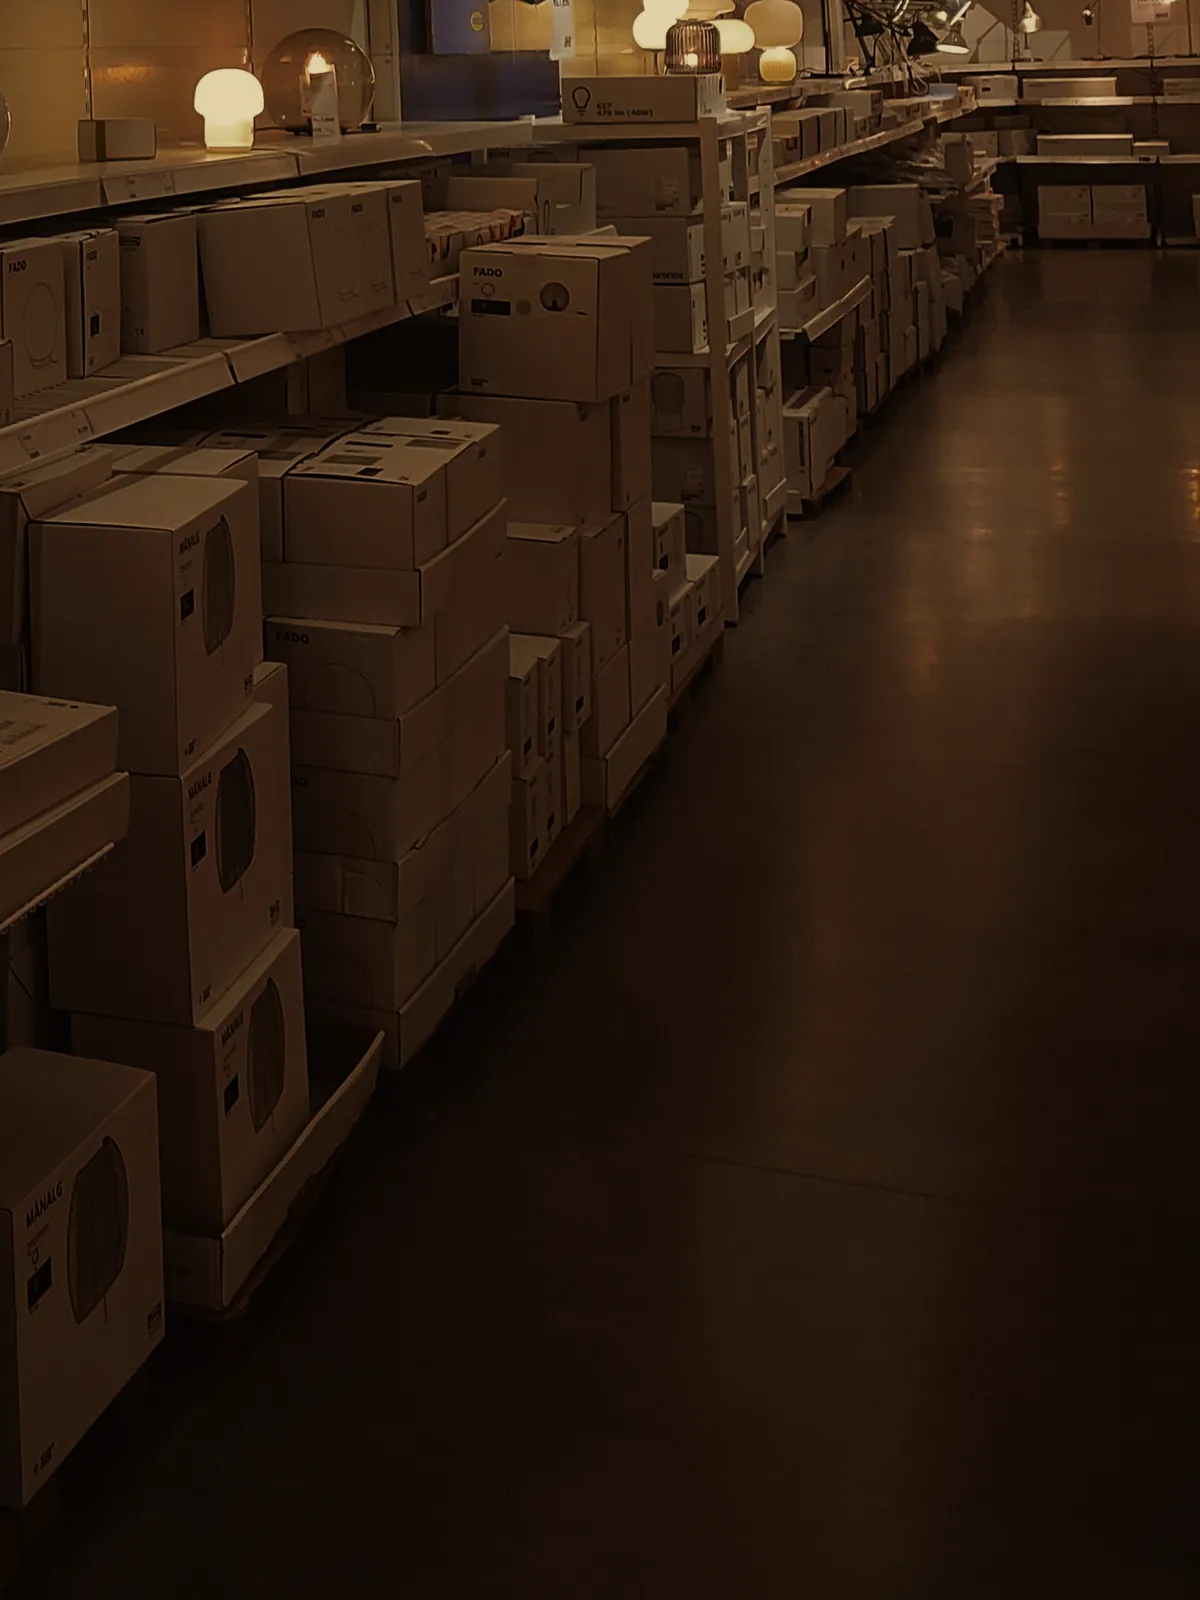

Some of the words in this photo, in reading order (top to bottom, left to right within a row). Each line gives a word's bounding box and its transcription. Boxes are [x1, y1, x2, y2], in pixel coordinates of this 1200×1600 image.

[8, 260, 27, 274] FADO
[472, 266, 503, 278] FADO
[275, 630, 310, 644] FADO
